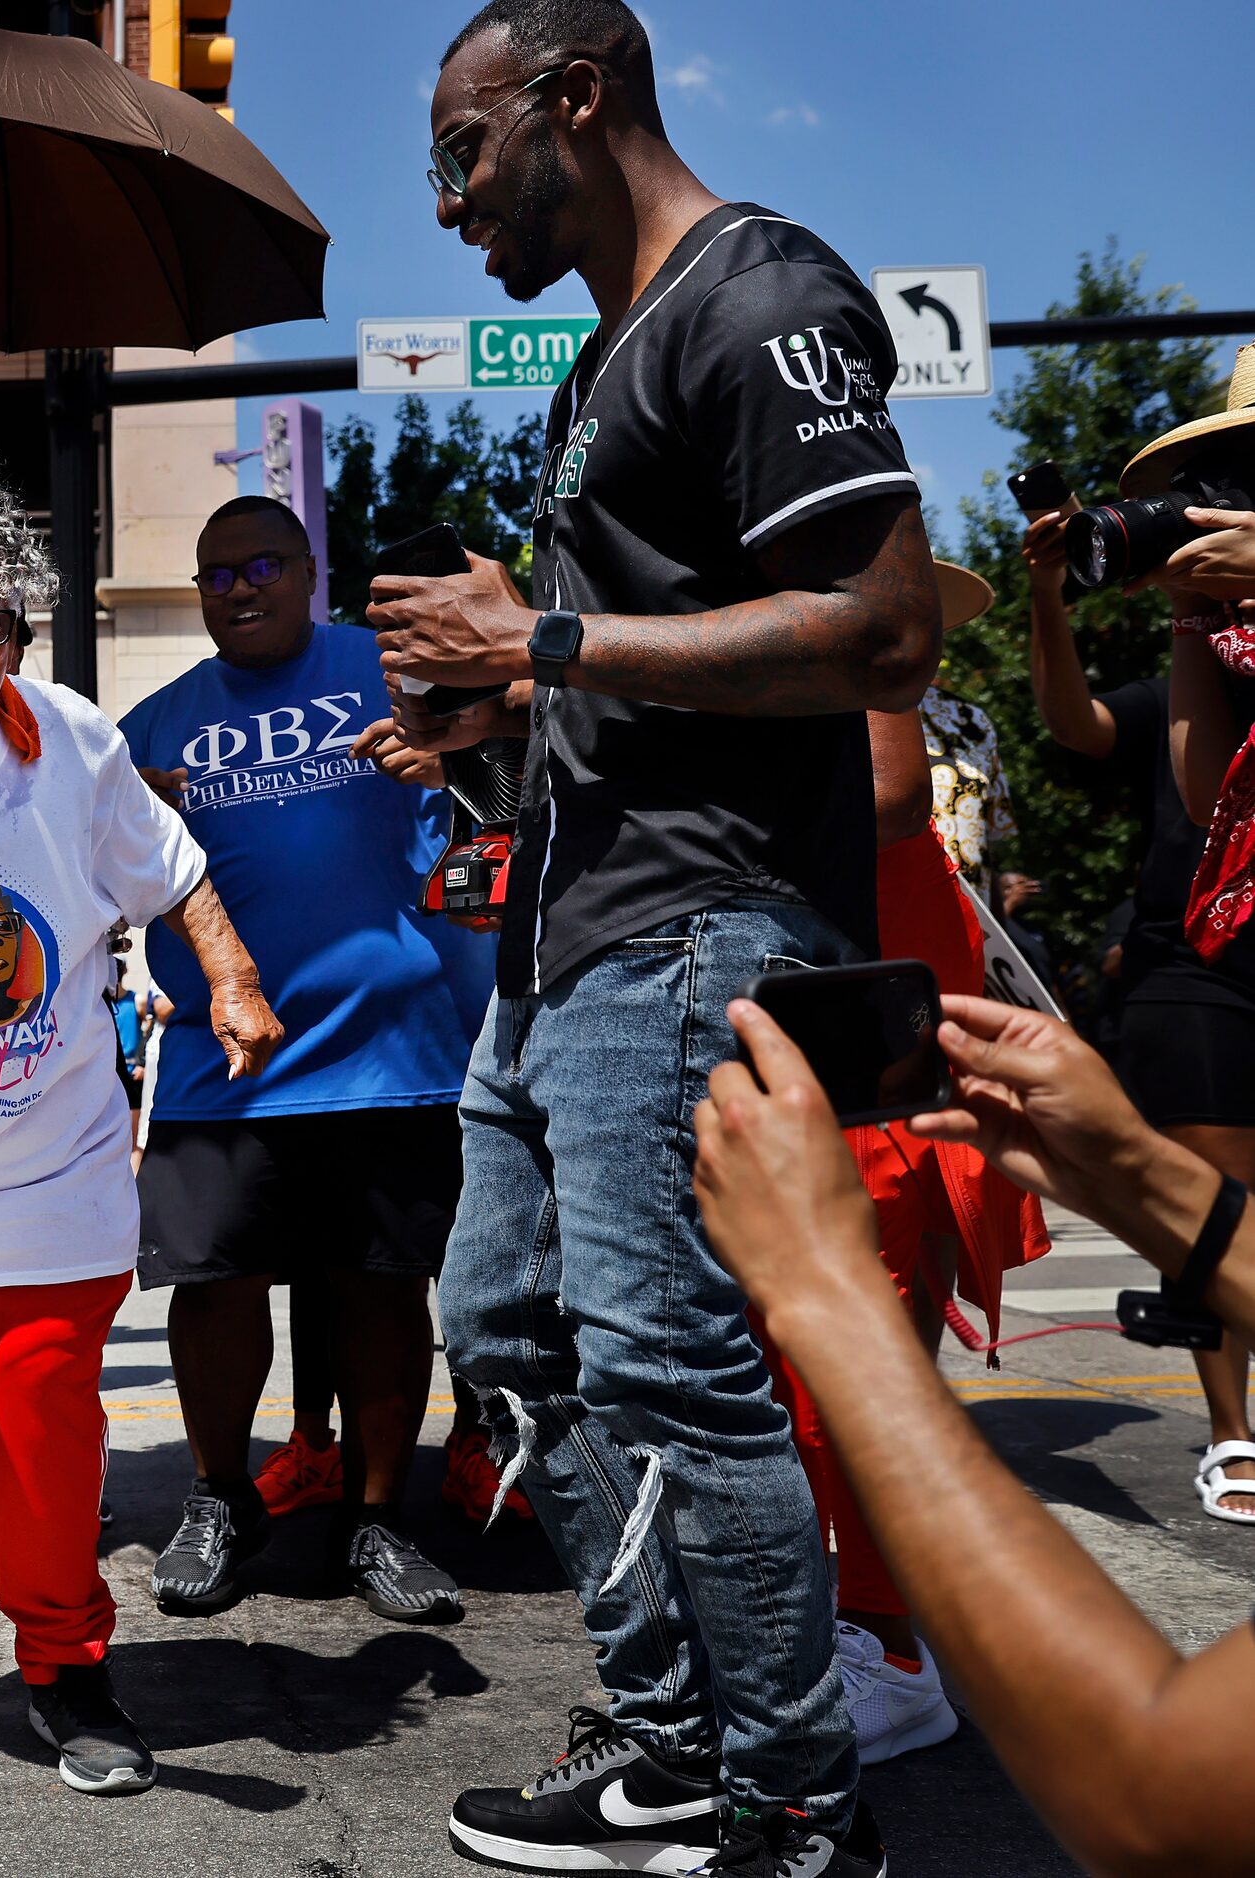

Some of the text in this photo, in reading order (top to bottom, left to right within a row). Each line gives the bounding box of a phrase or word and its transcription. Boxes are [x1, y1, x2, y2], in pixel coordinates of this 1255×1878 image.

[479, 325, 591, 364] Com
[512, 366, 554, 384] 500
[896, 361, 972, 386] ONLY
[184, 757, 377, 812] PHI BETA SIGMA
[220, 799, 242, 809] Culture
[277, 789, 299, 799] Service
[299, 787, 310, 795] for
[310, 780, 341, 792] Humanity
[448, 869, 464, 878] M18
[31, 1090, 43, 1101] DC
